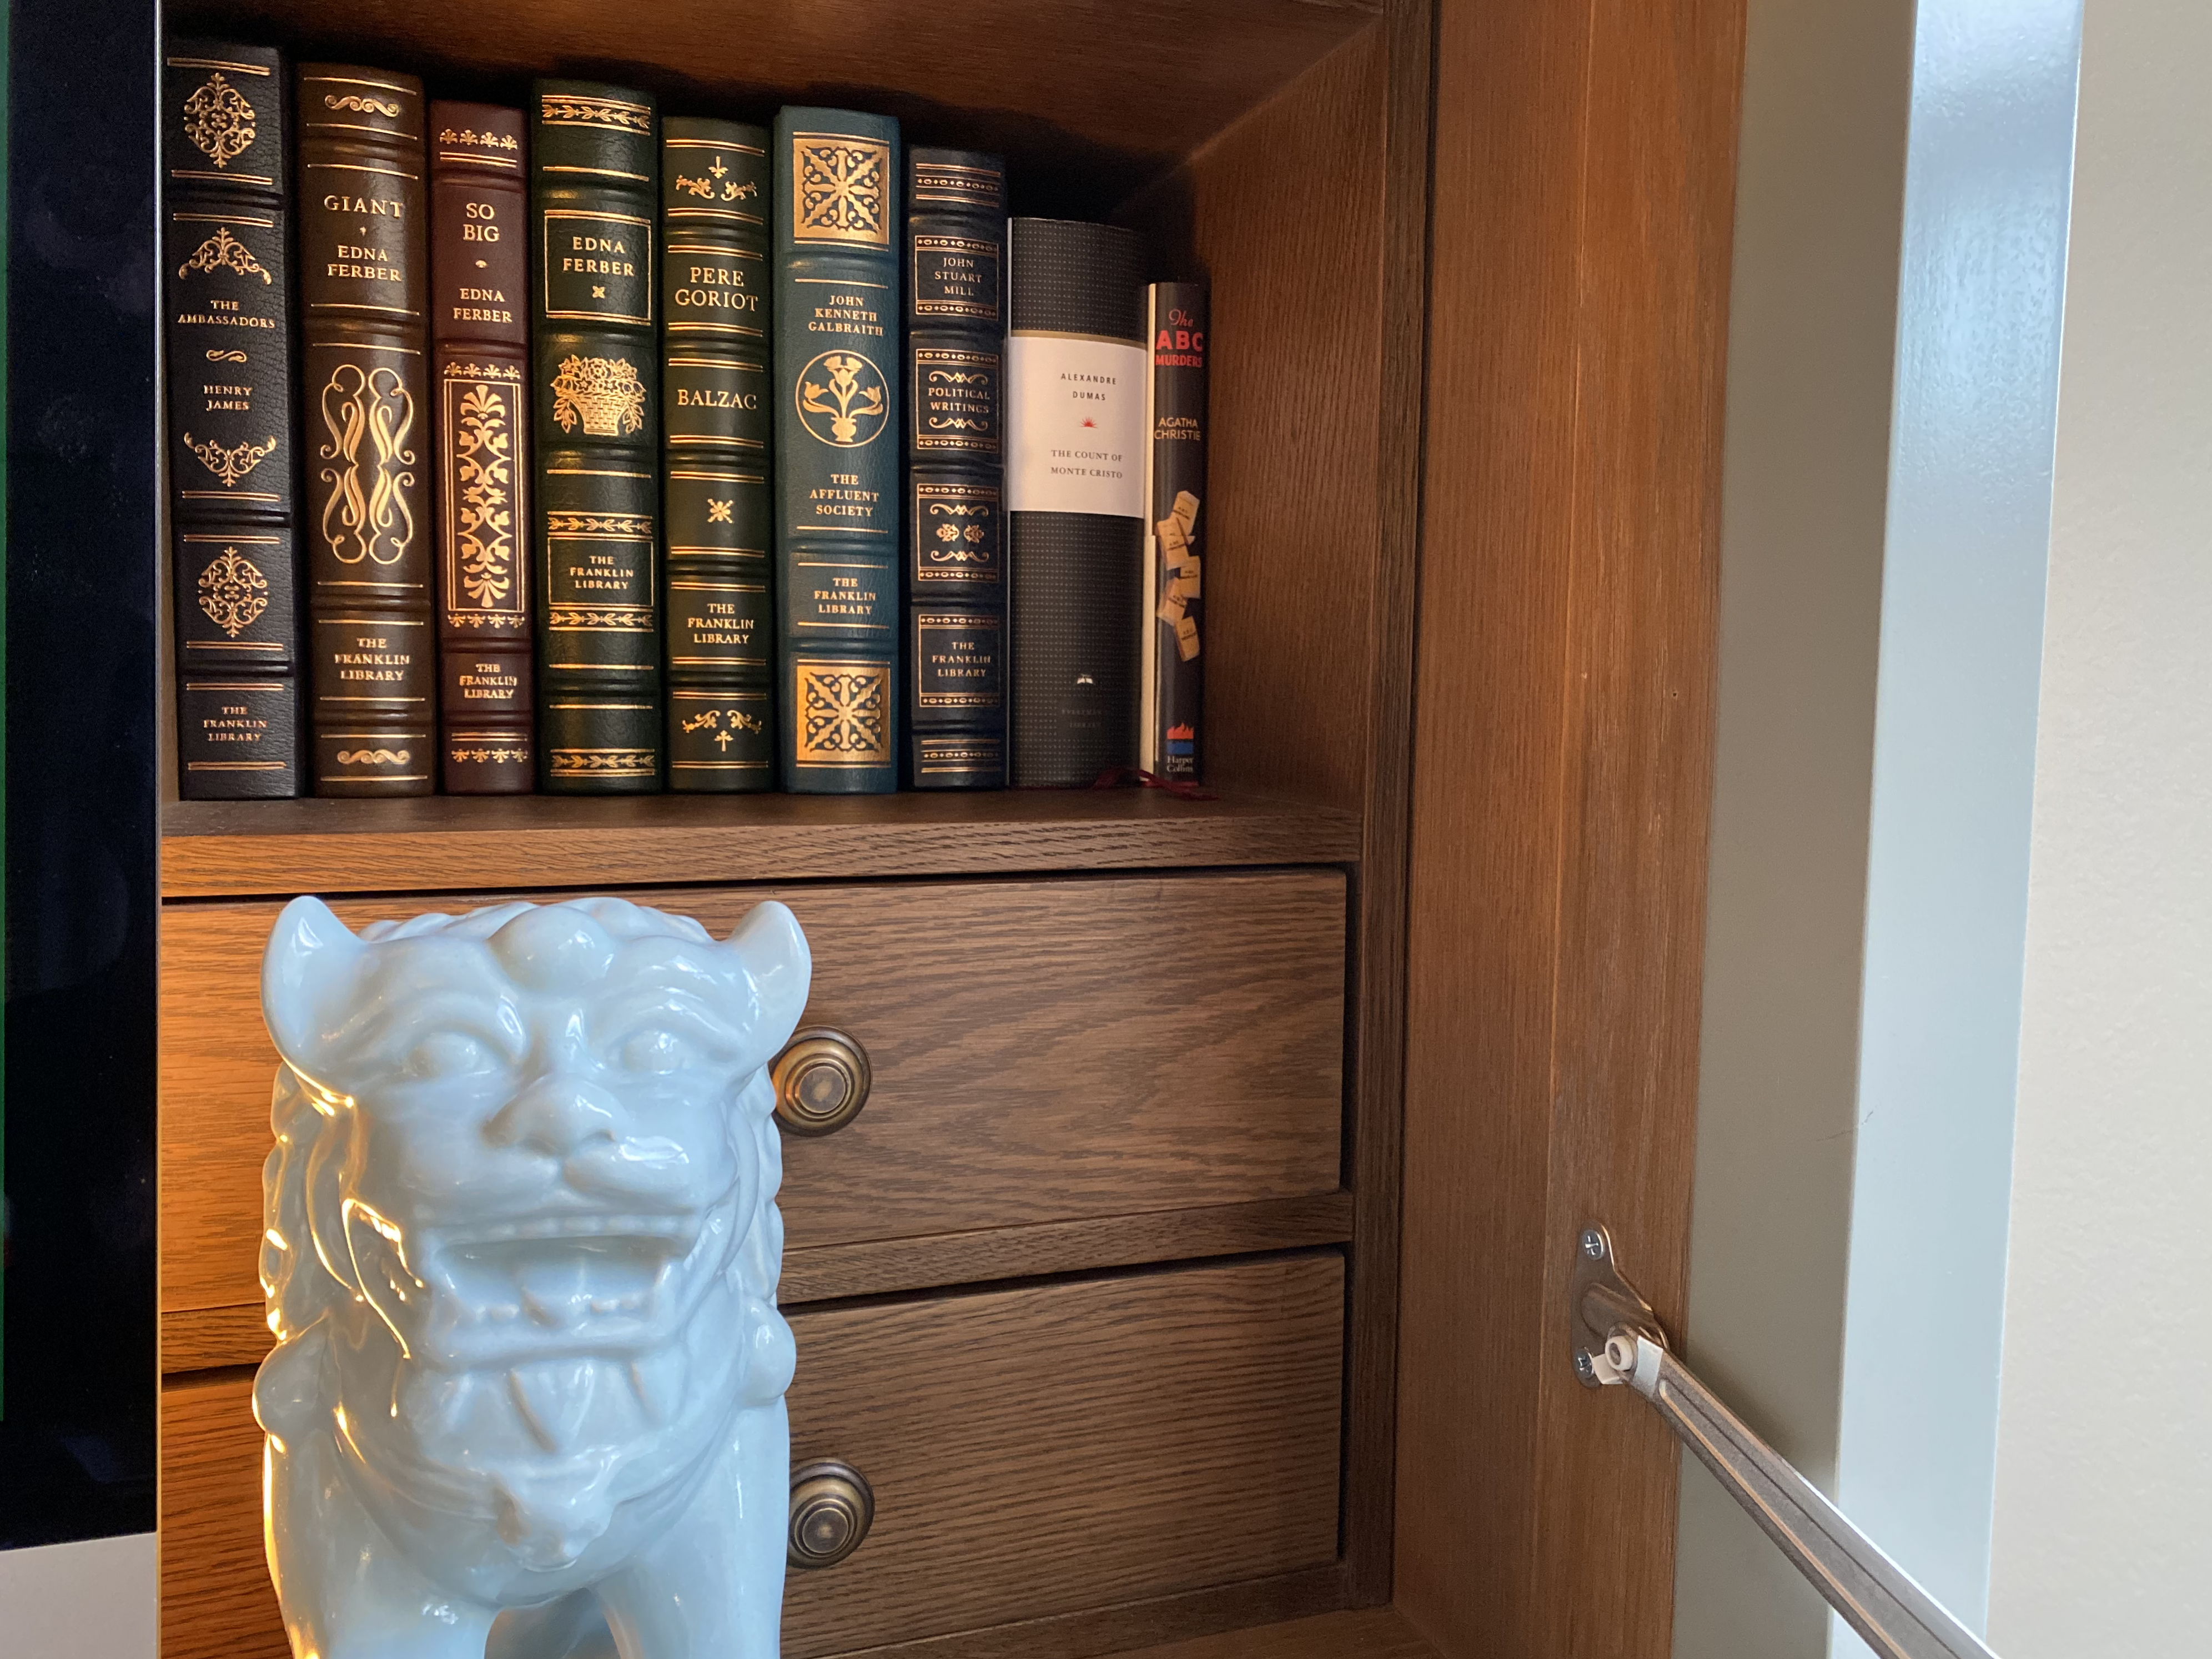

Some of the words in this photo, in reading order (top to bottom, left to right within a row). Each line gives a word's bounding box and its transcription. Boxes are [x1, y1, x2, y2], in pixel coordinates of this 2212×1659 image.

[324, 195, 403, 217] GIANT
[466, 203, 495, 220] SO
[463, 224, 500, 242] BIG
[572, 237, 625, 253] EDNA
[338, 245, 388, 262] EDNA
[563, 258, 635, 276] FERBER
[943, 258, 974, 268] JOHN
[328, 264, 402, 281] FERBER
[690, 267, 744, 287] PERE
[935, 271, 982, 283] STUART
[460, 288, 505, 303] EDNA
[944, 285, 974, 296] MILL
[211, 300, 239, 311] THE
[675, 289, 758, 311] GORIOT
[830, 295, 864, 306] JOHN
[453, 308, 512, 323] FERBER
[815, 308, 877, 321] KENNETH
[1169, 309, 1193, 328] The
[178, 314, 275, 329] AMBASSADORS
[808, 321, 883, 336] GALBRAITH
[1156, 331, 1203, 351] ABC
[1155, 354, 1202, 368] MURDERS
[1061, 373, 1117, 385] ALEXANDRE
[204, 385, 253, 396] HENRY
[928, 387, 990, 399] POLITICAL
[1073, 391, 1106, 401] DUMAS
[206, 400, 249, 410] JAMES
[678, 389, 756, 410] BALZAC
[930, 403, 989, 414] WRITINGS
[1158, 418, 1198, 428] AGATHA
[1154, 429, 1200, 440] CHRISTIE
[1052, 450, 1072, 459] THE
[1075, 450, 1109, 460] COUNT
[1112, 453, 1123, 461] OF
[1051, 466, 1087, 476] MONTE
[1089, 468, 1123, 479] CRISTO
[831, 474, 858, 485] THE
[810, 489, 879, 502] AFFLUENT
[816, 505, 873, 517] SOCIETY
[589, 556, 614, 565] THE
[570, 567, 634, 577] FRANKLIN
[575, 580, 629, 590] LIBRARY
[833, 578, 858, 587] THE
[815, 591, 876, 601] FRANKLIN
[707, 604, 735, 614] THE
[818, 605, 872, 615] LIBRARY
[687, 617, 754, 630] FRANKLIN
[357, 638, 386, 648] THE
[693, 633, 749, 644] LIBRARY
[952, 642, 974, 650] THE
[335, 654, 410, 665] FRANKLIN
[932, 655, 991, 663] FRANKLIN
[476, 664, 500, 673] THE
[938, 668, 986, 677] LIBRARY
[340, 670, 405, 681] LIBRARY
[460, 676, 517, 686] FRANKLIN
[464, 689, 514, 699] LIBRARY
[221, 706, 248, 715] THE
[203, 720, 267, 728] FRANKLIN
[208, 733, 262, 742] LIBRARY
